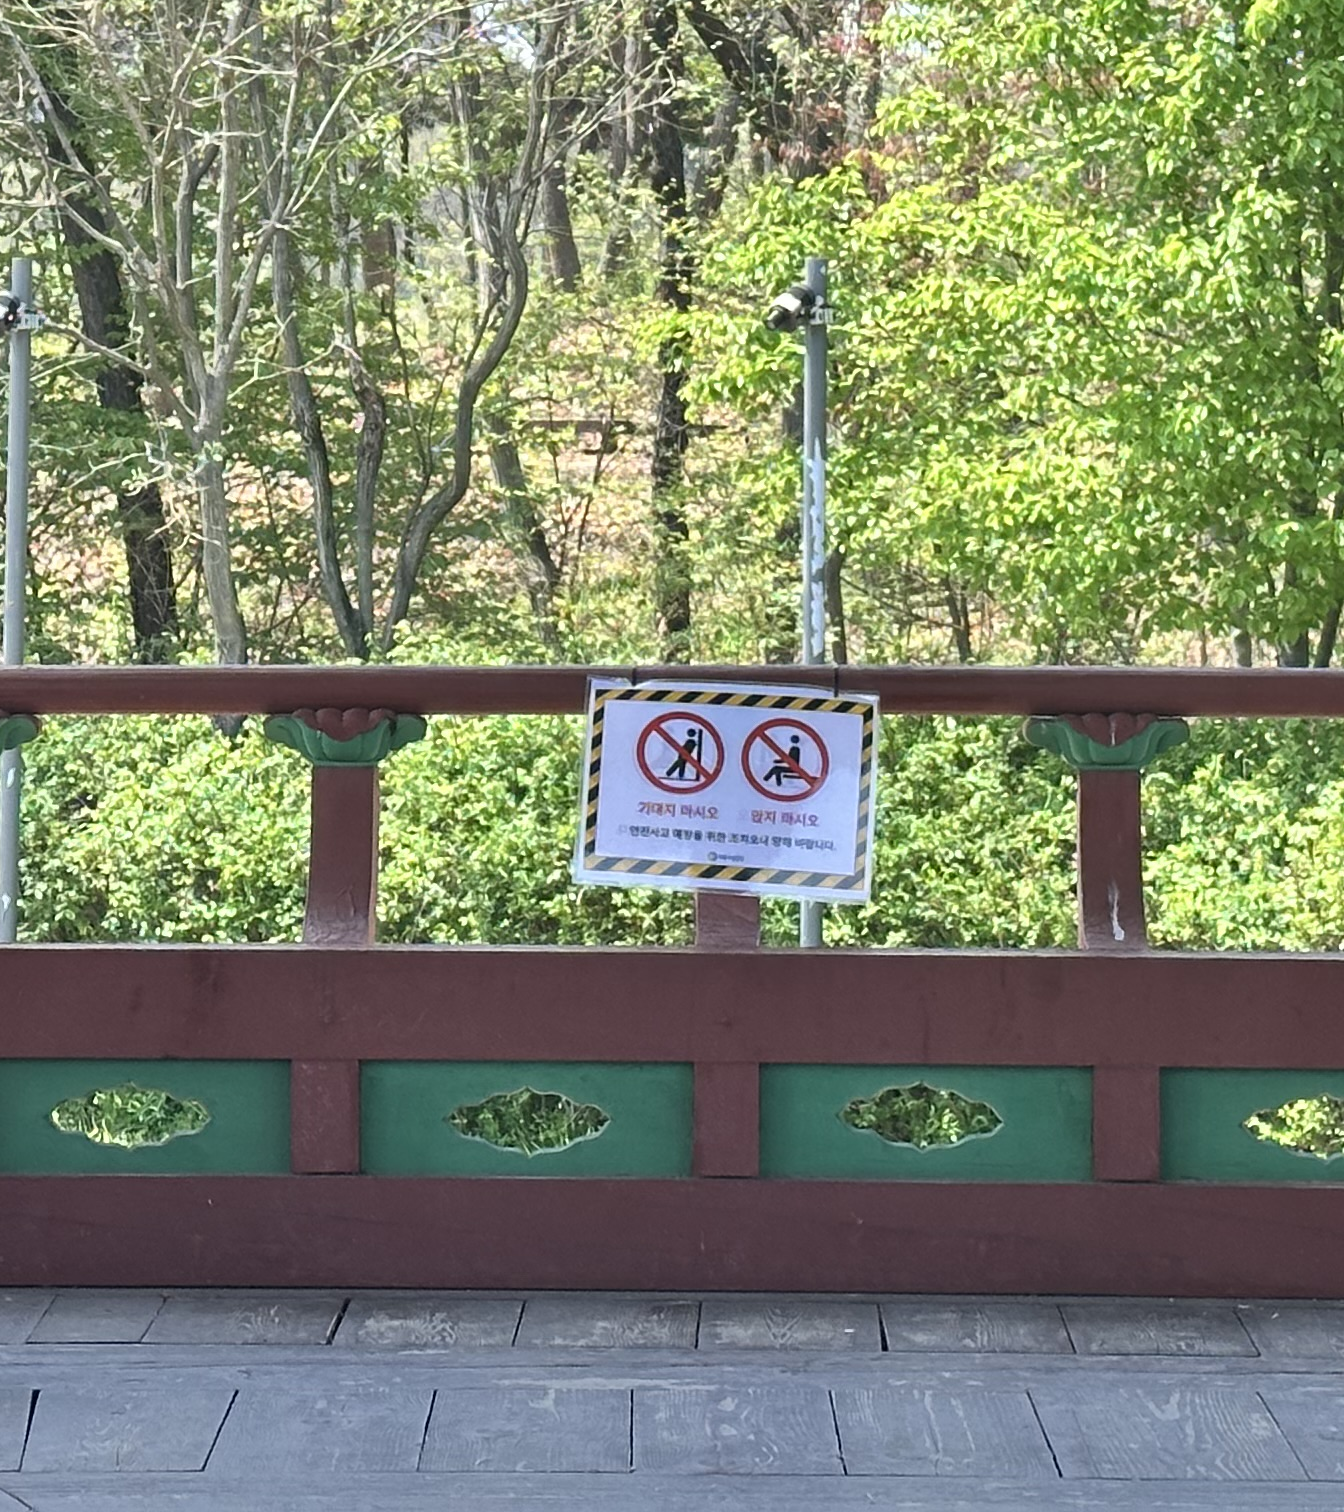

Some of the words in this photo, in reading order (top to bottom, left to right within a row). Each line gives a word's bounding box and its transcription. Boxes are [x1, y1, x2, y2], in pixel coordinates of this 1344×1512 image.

[637, 801, 676, 818] 기대지
[680, 804, 719, 820] 마시오
[751, 809, 777, 825] 앉지
[781, 811, 820, 827] 마시오
[628, 825, 670, 838] 안전사고
[706, 830, 726, 843] 위한
